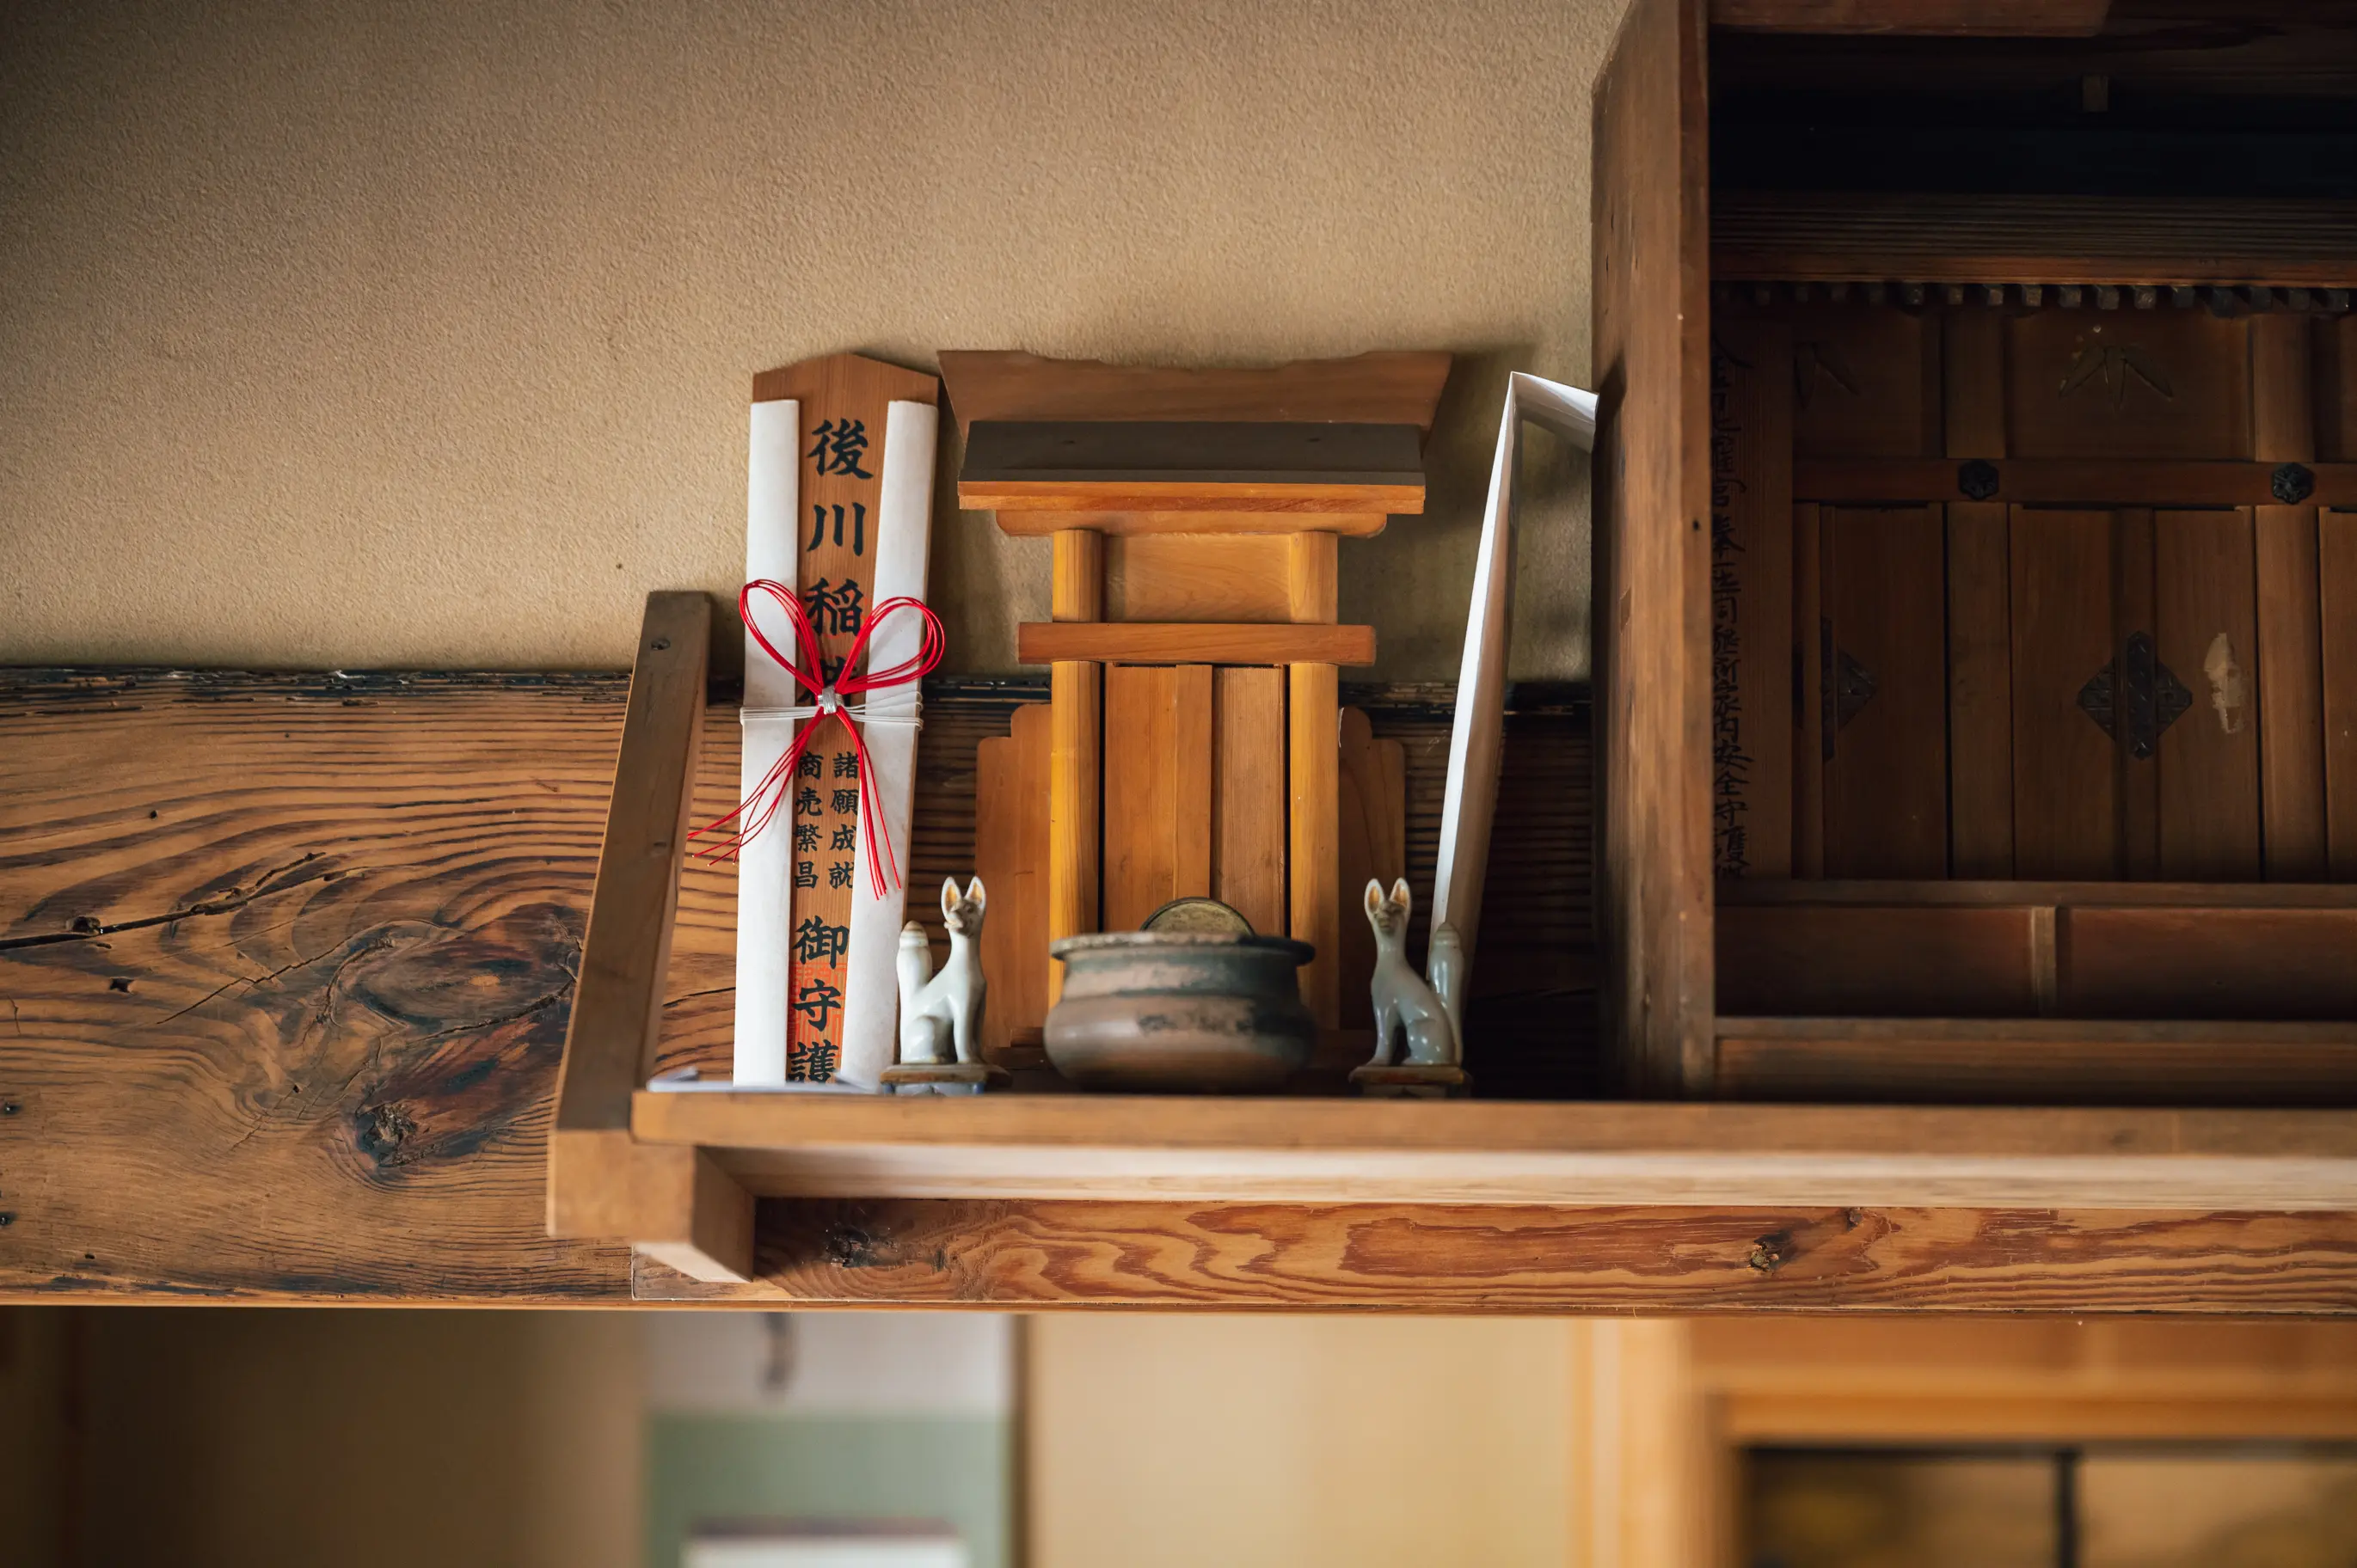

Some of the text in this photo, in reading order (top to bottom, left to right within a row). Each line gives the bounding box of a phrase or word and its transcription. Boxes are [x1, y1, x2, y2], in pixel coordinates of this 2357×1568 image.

[794, 750, 824, 890] 商売繁昌
[828, 751, 859, 890] 諸願成就
[788, 915, 850, 1082] 御守護
